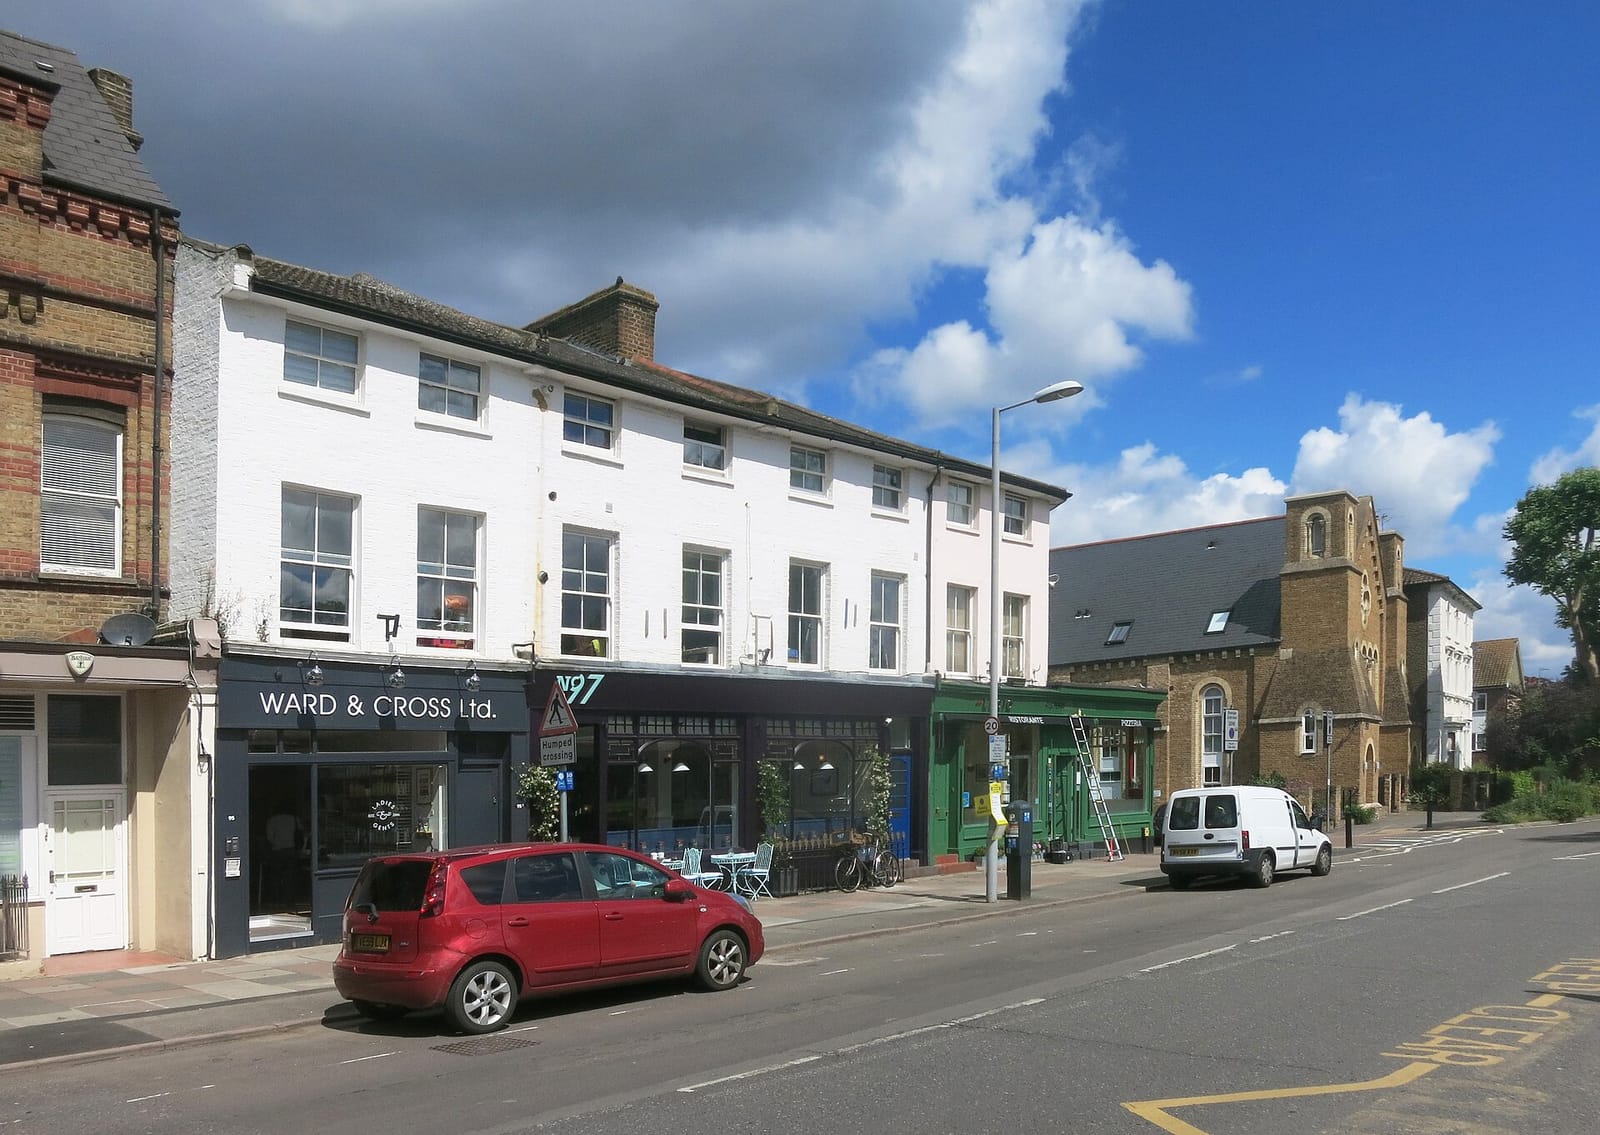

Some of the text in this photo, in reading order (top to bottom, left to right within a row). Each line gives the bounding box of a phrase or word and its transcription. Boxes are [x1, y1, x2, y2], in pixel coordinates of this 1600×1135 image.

[259, 692, 497, 719] WARD & CROSS Ltd.
[986, 721, 998, 730] 20
[542, 737, 572, 749] Humped
[543, 750, 573, 761] crossing
[1379, 1005, 1570, 1066] CLEAR
